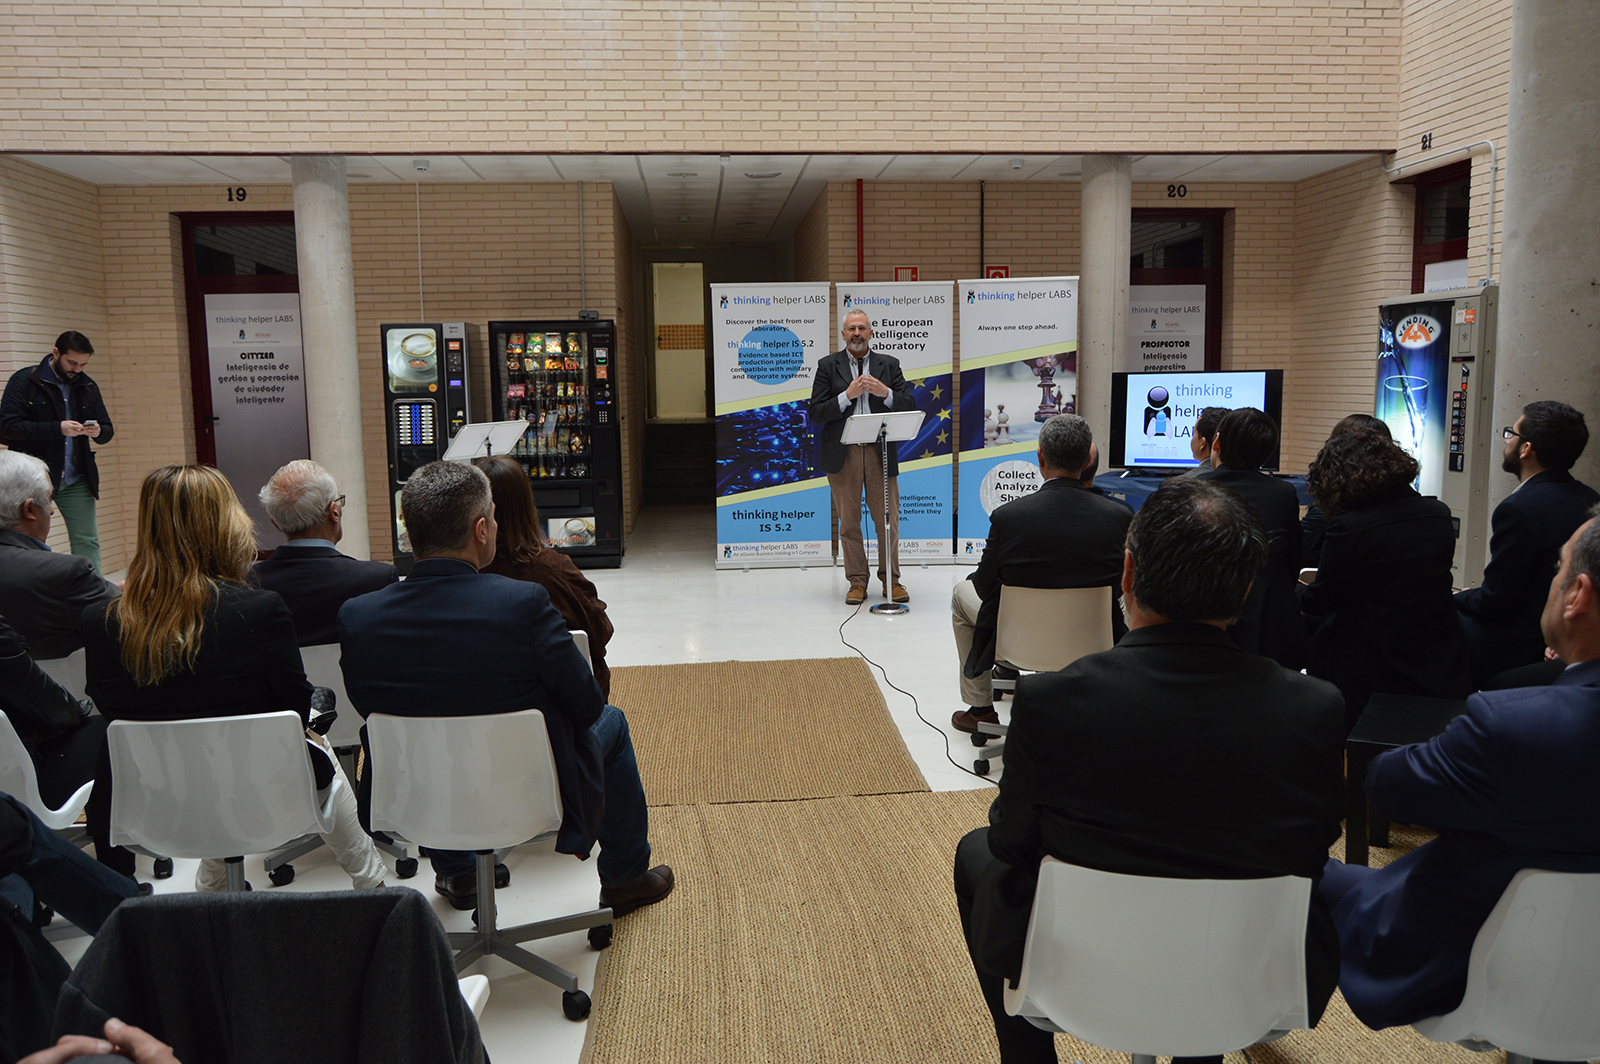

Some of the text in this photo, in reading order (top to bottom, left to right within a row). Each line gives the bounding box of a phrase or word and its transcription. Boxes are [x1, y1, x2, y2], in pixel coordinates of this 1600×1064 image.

[1421, 132, 1433, 150] 21
[227, 187, 246, 202] 19
[1166, 184, 1187, 198] 20
[733, 295, 826, 306] thinking helper LABS
[978, 290, 1072, 301] thinking helper LABS
[854, 296, 945, 306] thinking helper LABS
[1160, 306, 1182, 314] helper
[216, 316, 247, 324] thinking
[248, 316, 273, 324] helper
[882, 318, 933, 328] European
[1398, 316, 1435, 337] VENDING
[727, 340, 762, 350] thinking
[763, 340, 790, 349] helper
[871, 342, 926, 352] aboratory
[1143, 352, 1187, 361] Inteligencia
[226, 363, 276, 372] Inteligencia
[1144, 363, 1186, 372] prospectiva
[247, 385, 284, 393] ciudades
[1175, 383, 1233, 399] thinking
[1175, 404, 1204, 419] help
[998, 471, 1035, 479] Collect
[995, 482, 1038, 492] Analyze
[732, 510, 815, 521] thinking helper
[759, 523, 792, 532] IS 5.2
